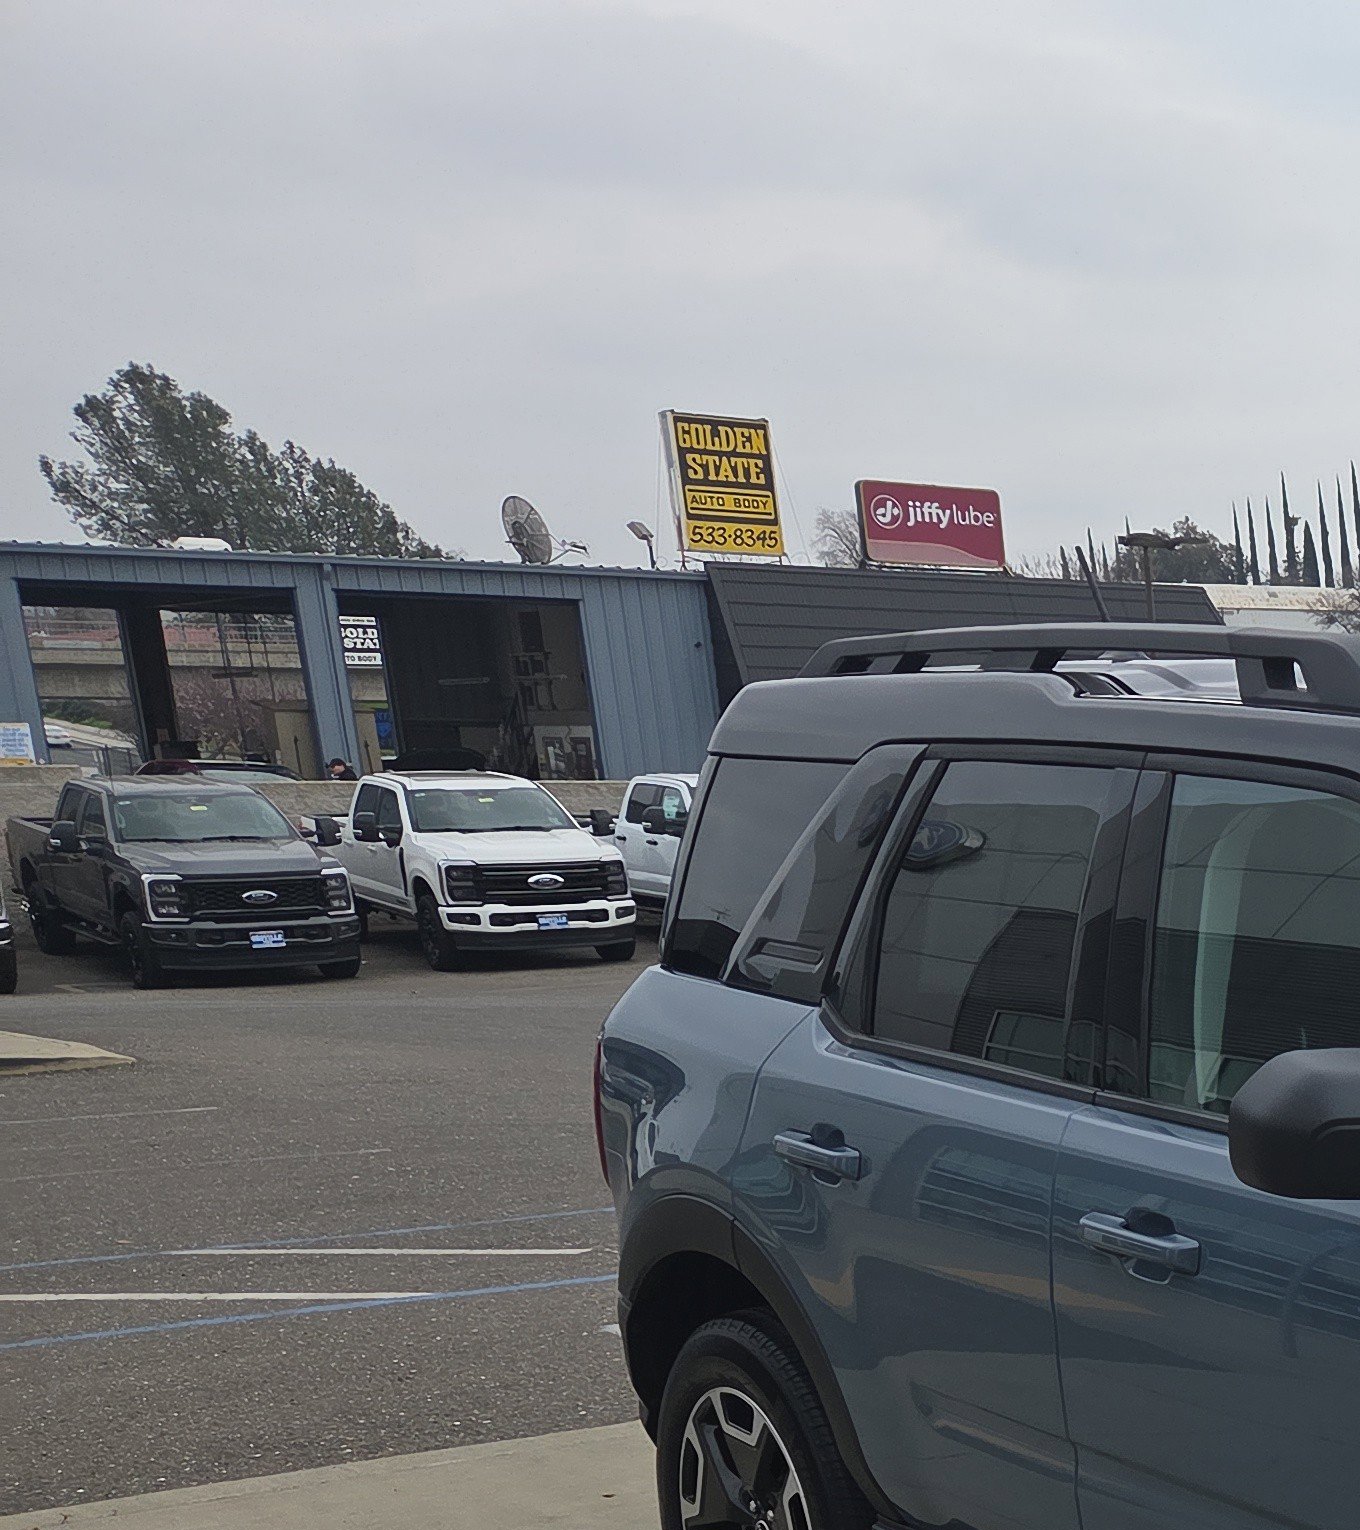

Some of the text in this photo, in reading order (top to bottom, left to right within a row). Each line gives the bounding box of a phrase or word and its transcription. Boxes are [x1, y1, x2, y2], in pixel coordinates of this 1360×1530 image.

[676, 422, 767, 455] GOLDEN
[685, 453, 766, 485] STATE
[690, 494, 769, 510] AUTO BODY
[907, 500, 995, 529] jiffy lube
